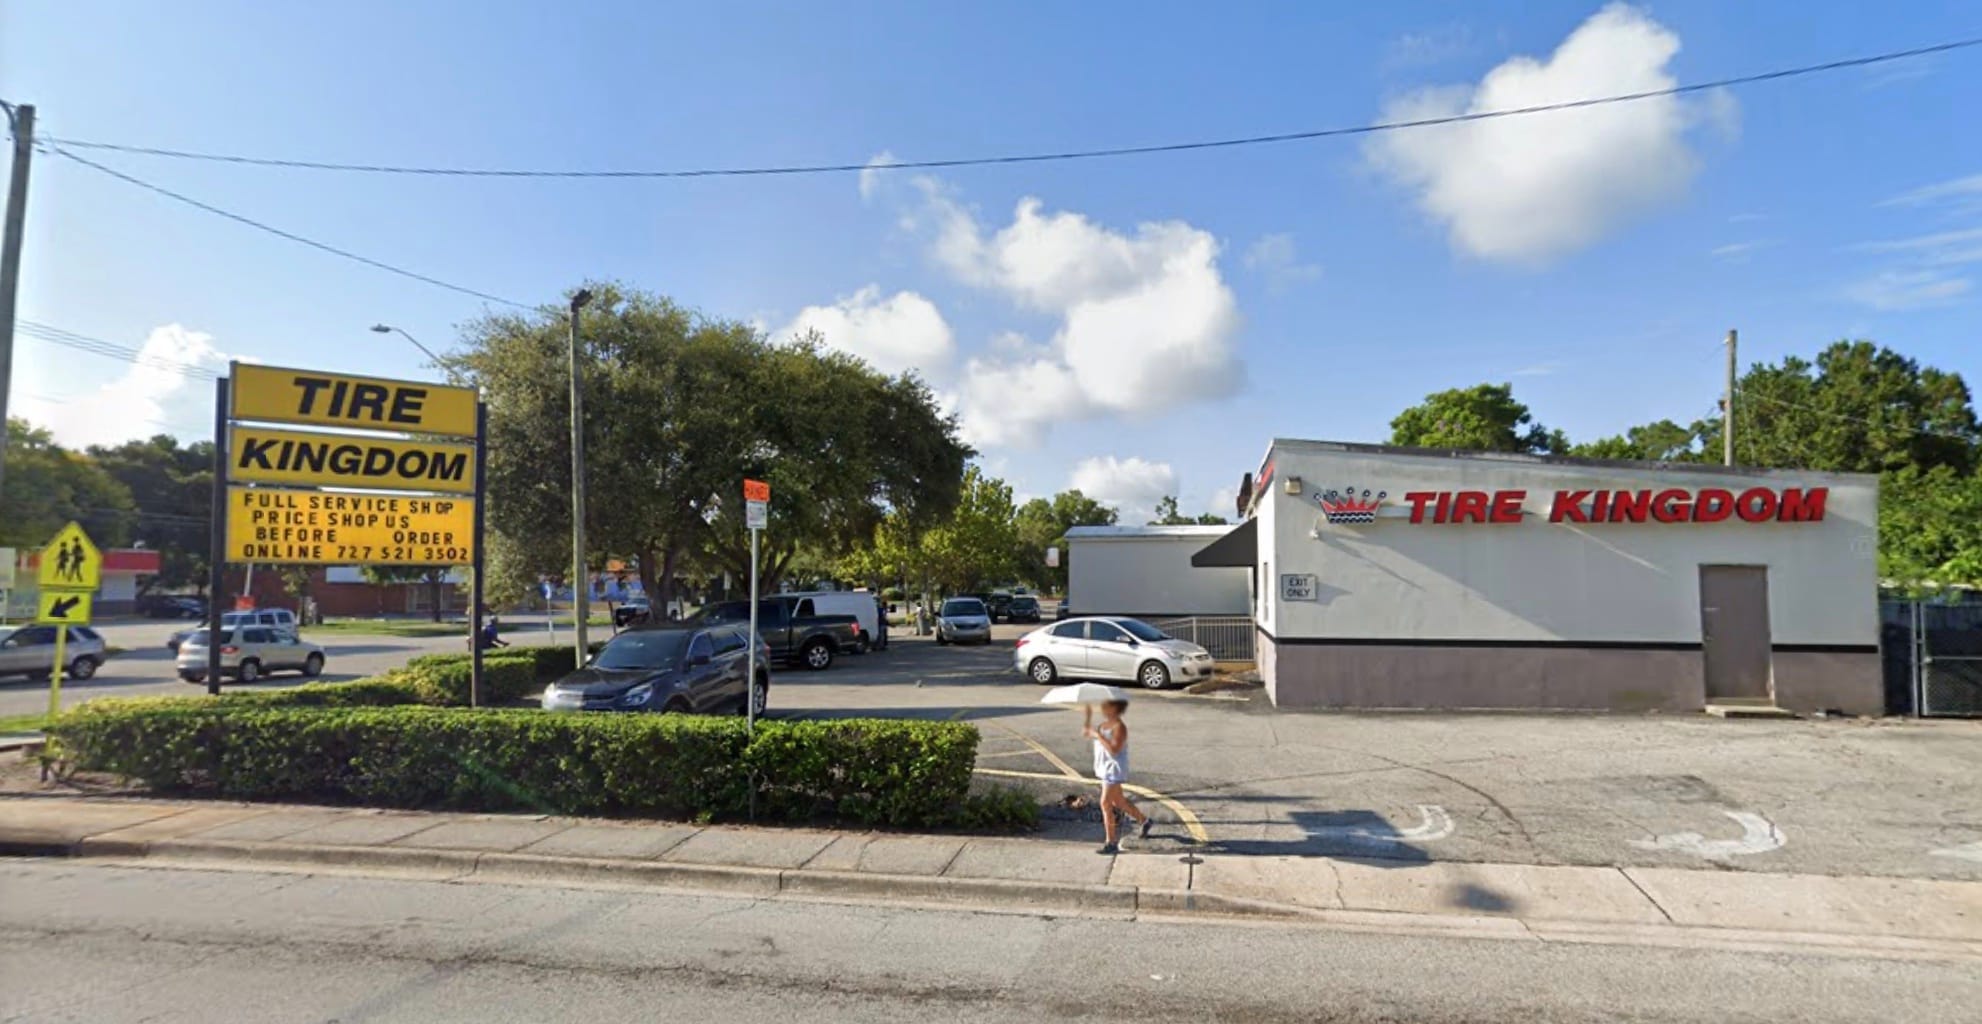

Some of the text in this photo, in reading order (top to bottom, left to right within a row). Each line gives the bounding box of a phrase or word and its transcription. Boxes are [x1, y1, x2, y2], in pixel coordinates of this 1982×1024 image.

[293, 376, 428, 424] TIRE
[238, 437, 467, 481] KINGDOM
[244, 493, 454, 515] FULL SERVICE SHOP
[1404, 487, 1829, 525] TIRE KINGDOM
[253, 510, 410, 529] PRICE SHOP US
[256, 526, 453, 545] BEFORE ORDER
[243, 544, 468, 561] ONLINE 727 521 3502
[1289, 577, 1308, 587] EXIT
[1286, 588, 1310, 598] ONLY
